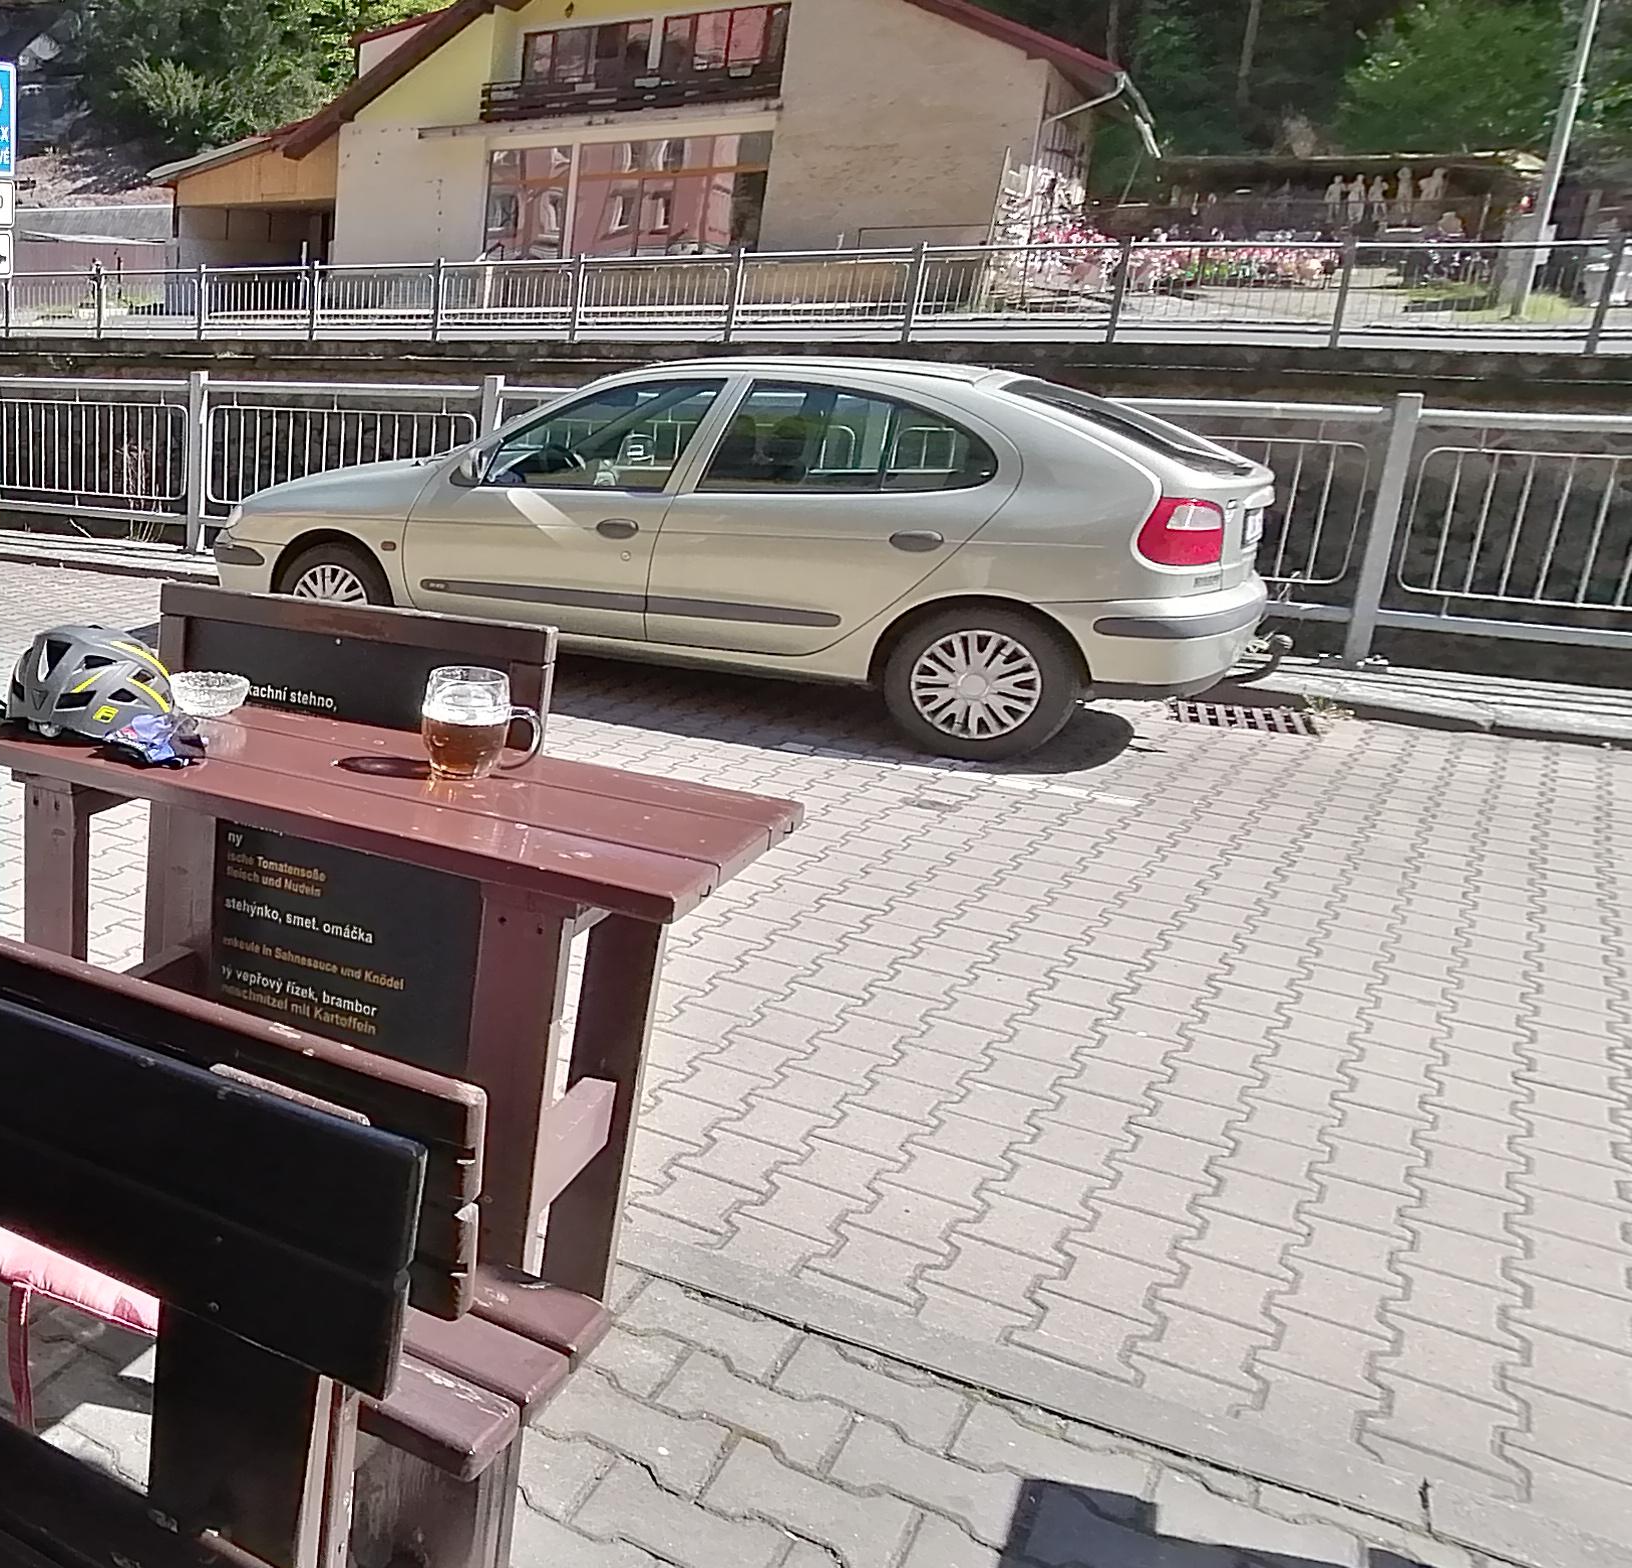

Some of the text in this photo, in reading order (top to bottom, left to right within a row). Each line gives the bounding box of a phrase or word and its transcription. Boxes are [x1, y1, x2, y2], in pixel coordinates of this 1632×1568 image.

[290, 689, 338, 713] stehno,
[256, 856, 327, 882] Tomatensoße
[261, 875, 282, 888] und
[283, 878, 321, 897] Nudeln
[285, 912, 320, 931] smet.
[322, 921, 374, 944] omáčka
[261, 943, 273, 957] in
[274, 946, 337, 973] Sahnesauce
[340, 965, 362, 980] und
[363, 970, 405, 991] Knödel
[235, 969, 283, 995] vepřový
[285, 980, 318, 1001] řízek,
[321, 990, 378, 1018] brambor
[290, 1001, 312, 1019] mit
[313, 1009, 377, 1036] Kartoffeln
